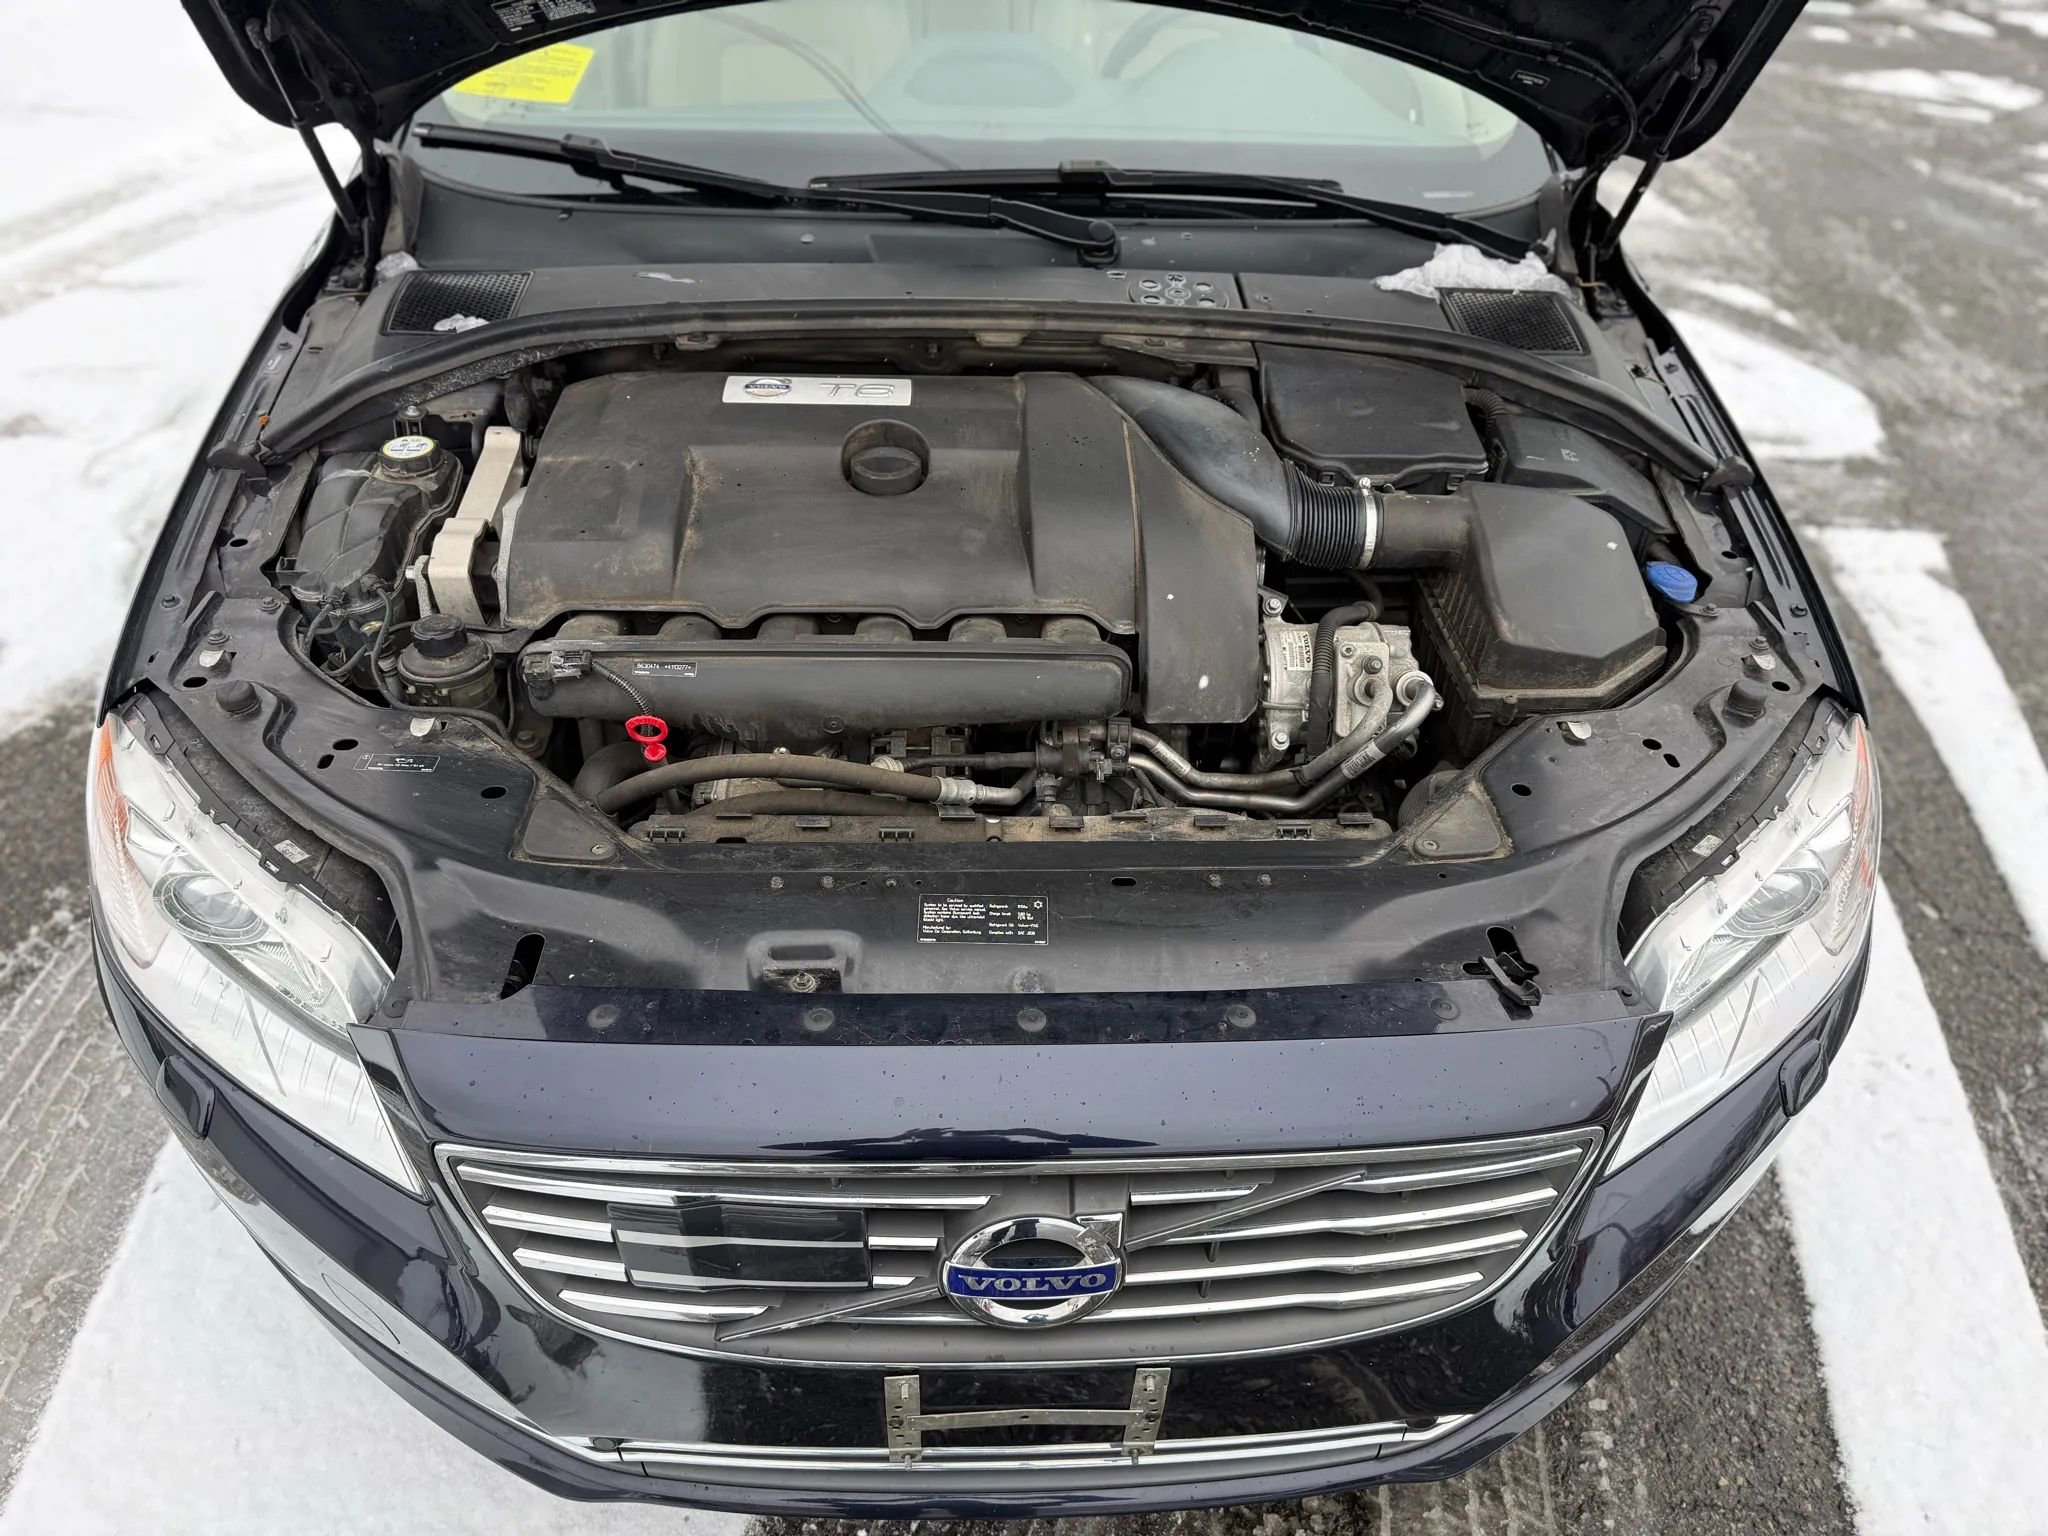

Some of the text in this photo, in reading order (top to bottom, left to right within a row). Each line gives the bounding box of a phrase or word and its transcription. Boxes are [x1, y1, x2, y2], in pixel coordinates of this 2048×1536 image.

[820, 382, 895, 399] T6
[1302, 634, 1312, 664] VOLVO
[957, 1273, 1107, 1292] VOLVO
